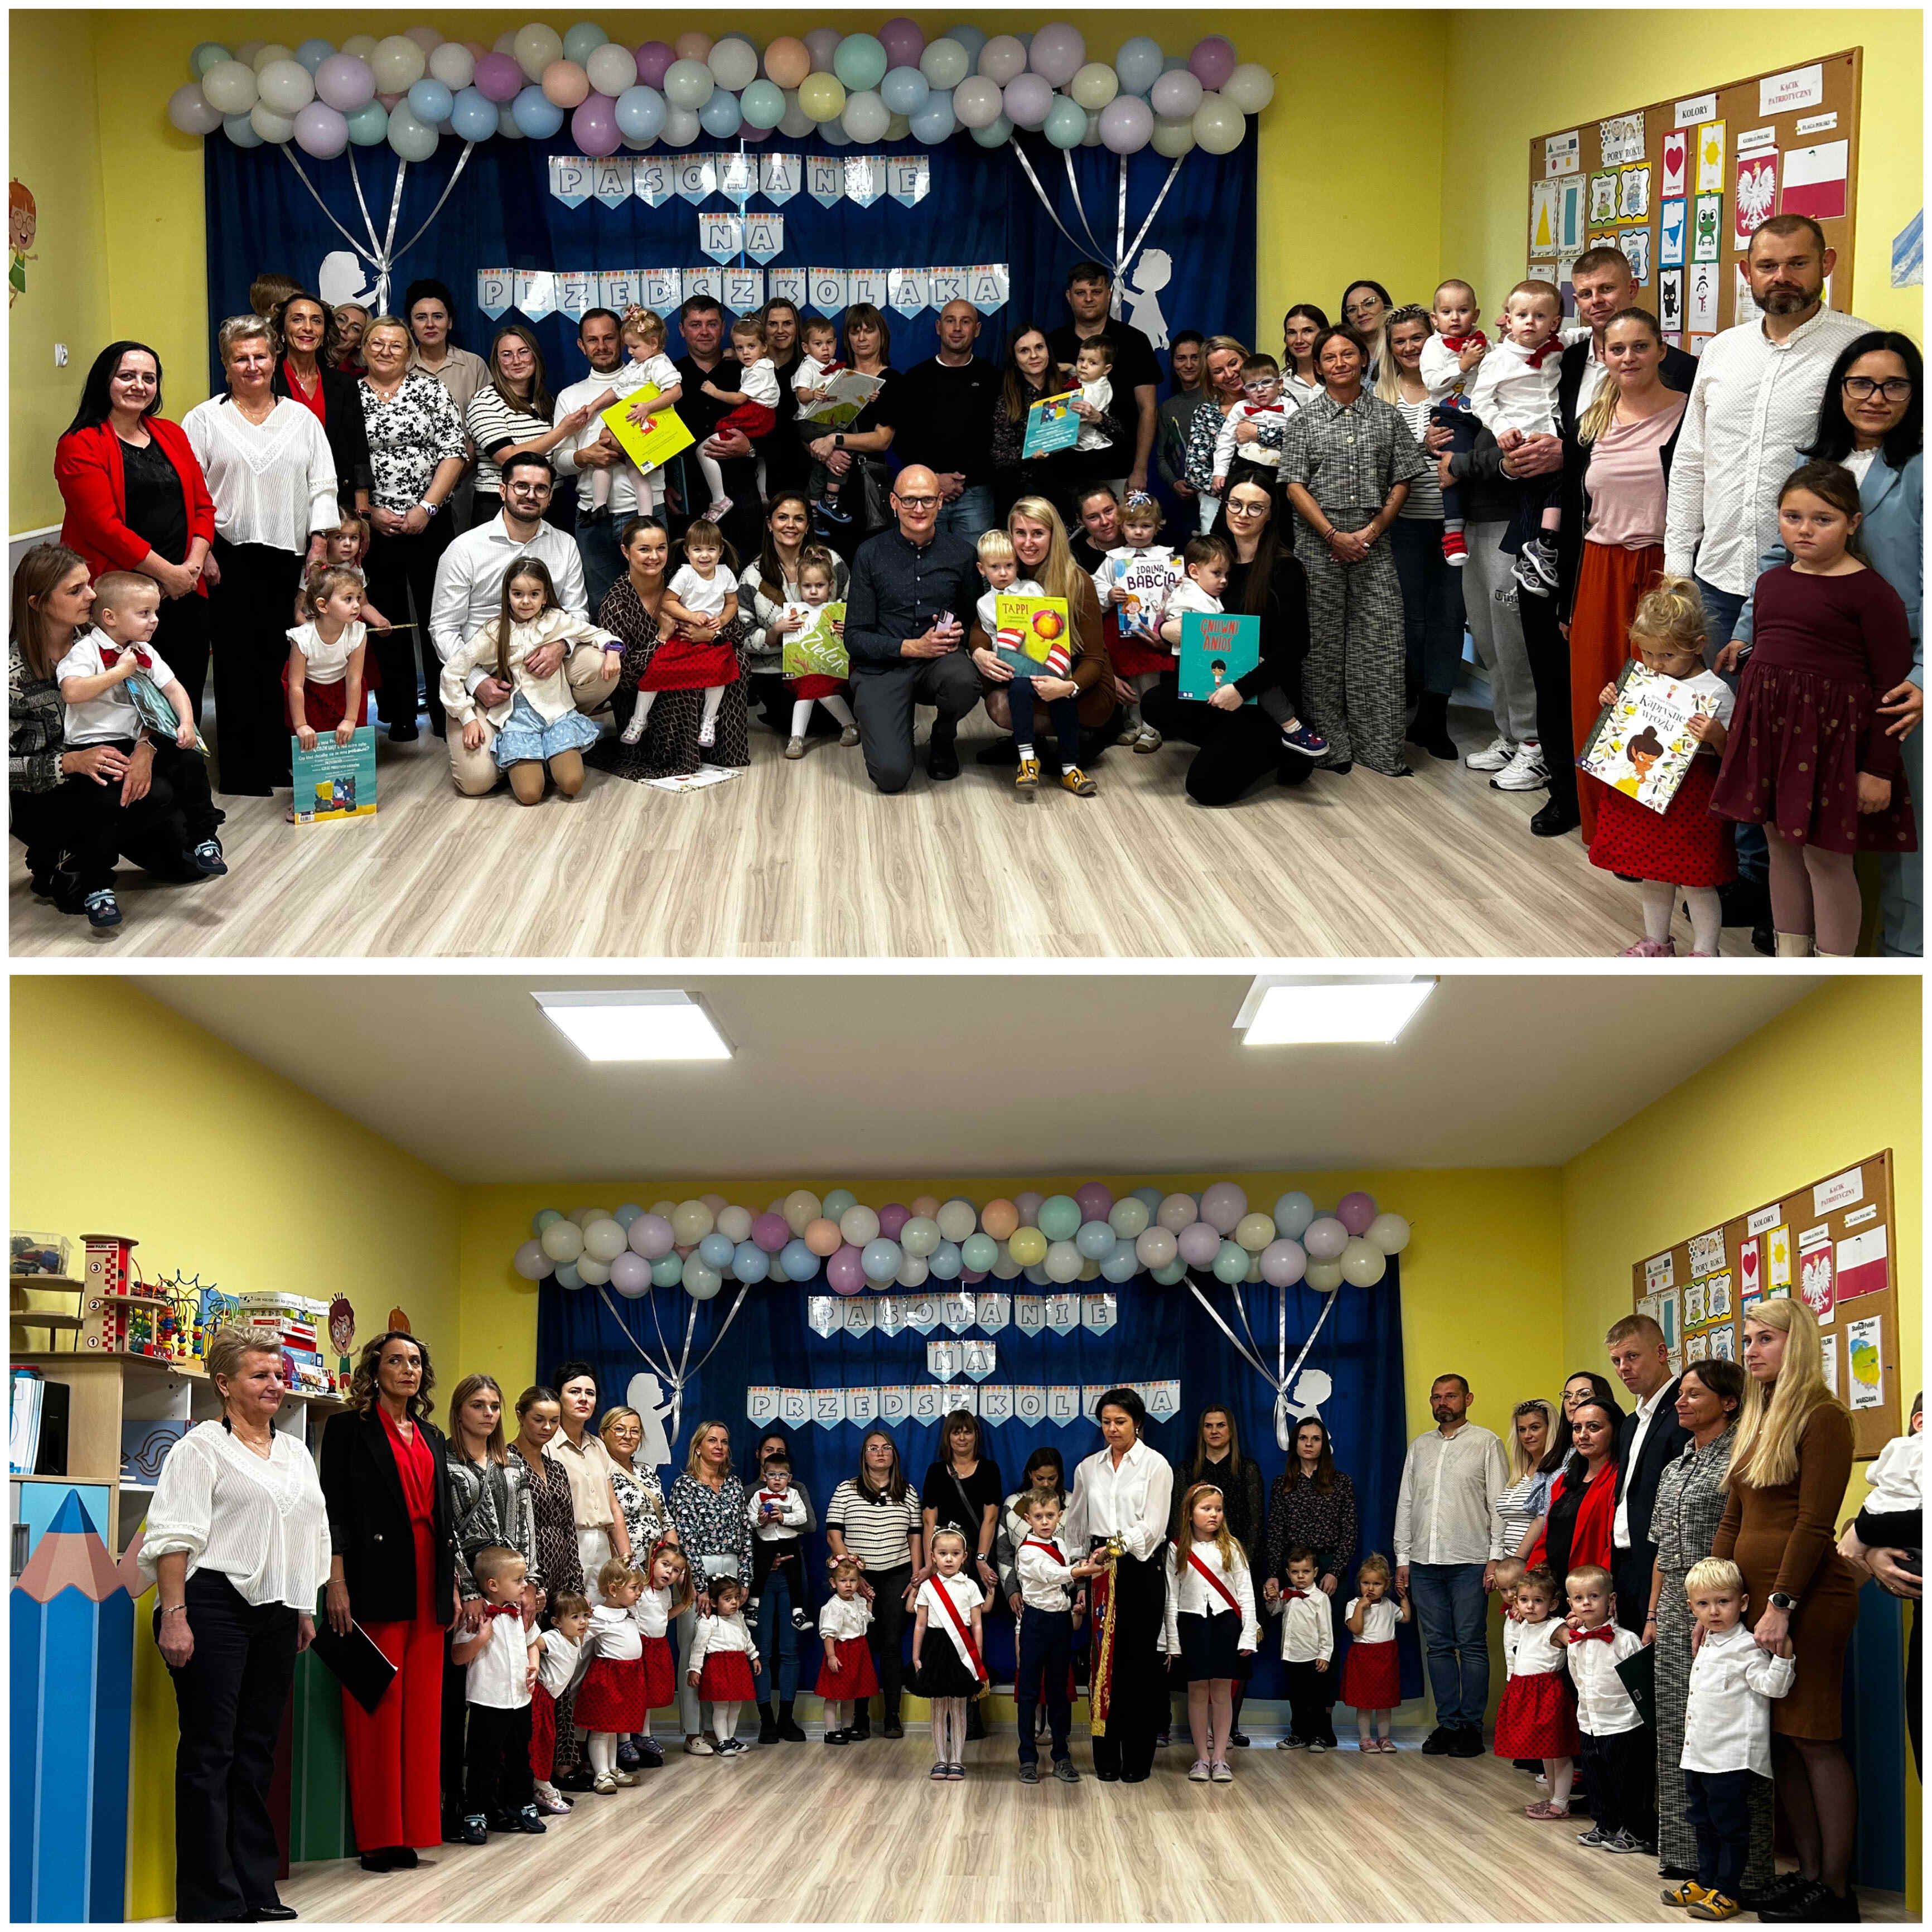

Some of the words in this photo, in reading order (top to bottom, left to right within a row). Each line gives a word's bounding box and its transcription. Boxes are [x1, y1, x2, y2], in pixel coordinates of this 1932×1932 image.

[1780, 80, 1799, 91] KĄCIK
[1768, 89, 1812, 105] PATRIOTYCZNY
[1682, 105, 1708, 119] KOLORY
[1607, 151, 1624, 162] PORY
[1625, 145, 1642, 159] ROKU
[559, 166, 919, 192] PASOWANE
[709, 225, 775, 249] NA
[485, 277, 999, 308] PZEDSZKOLAKA
[1136, 564, 1164, 574] ZDALNA
[1002, 603, 1028, 615] TAPPI
[1821, 1188, 1855, 1207] PATRIOTYCZNY
[1754, 1214, 1775, 1229] KOLORY
[1696, 1262, 1709, 1274] PORY
[1710, 1255, 1723, 1268] ROKU
[816, 1302, 1108, 1326] PASOWANIE
[934, 1350, 988, 1371] NA
[754, 1390, 1173, 1417] PRZEDSZKOLA
[1856, 1395, 1877, 1404] WARSZAWA
